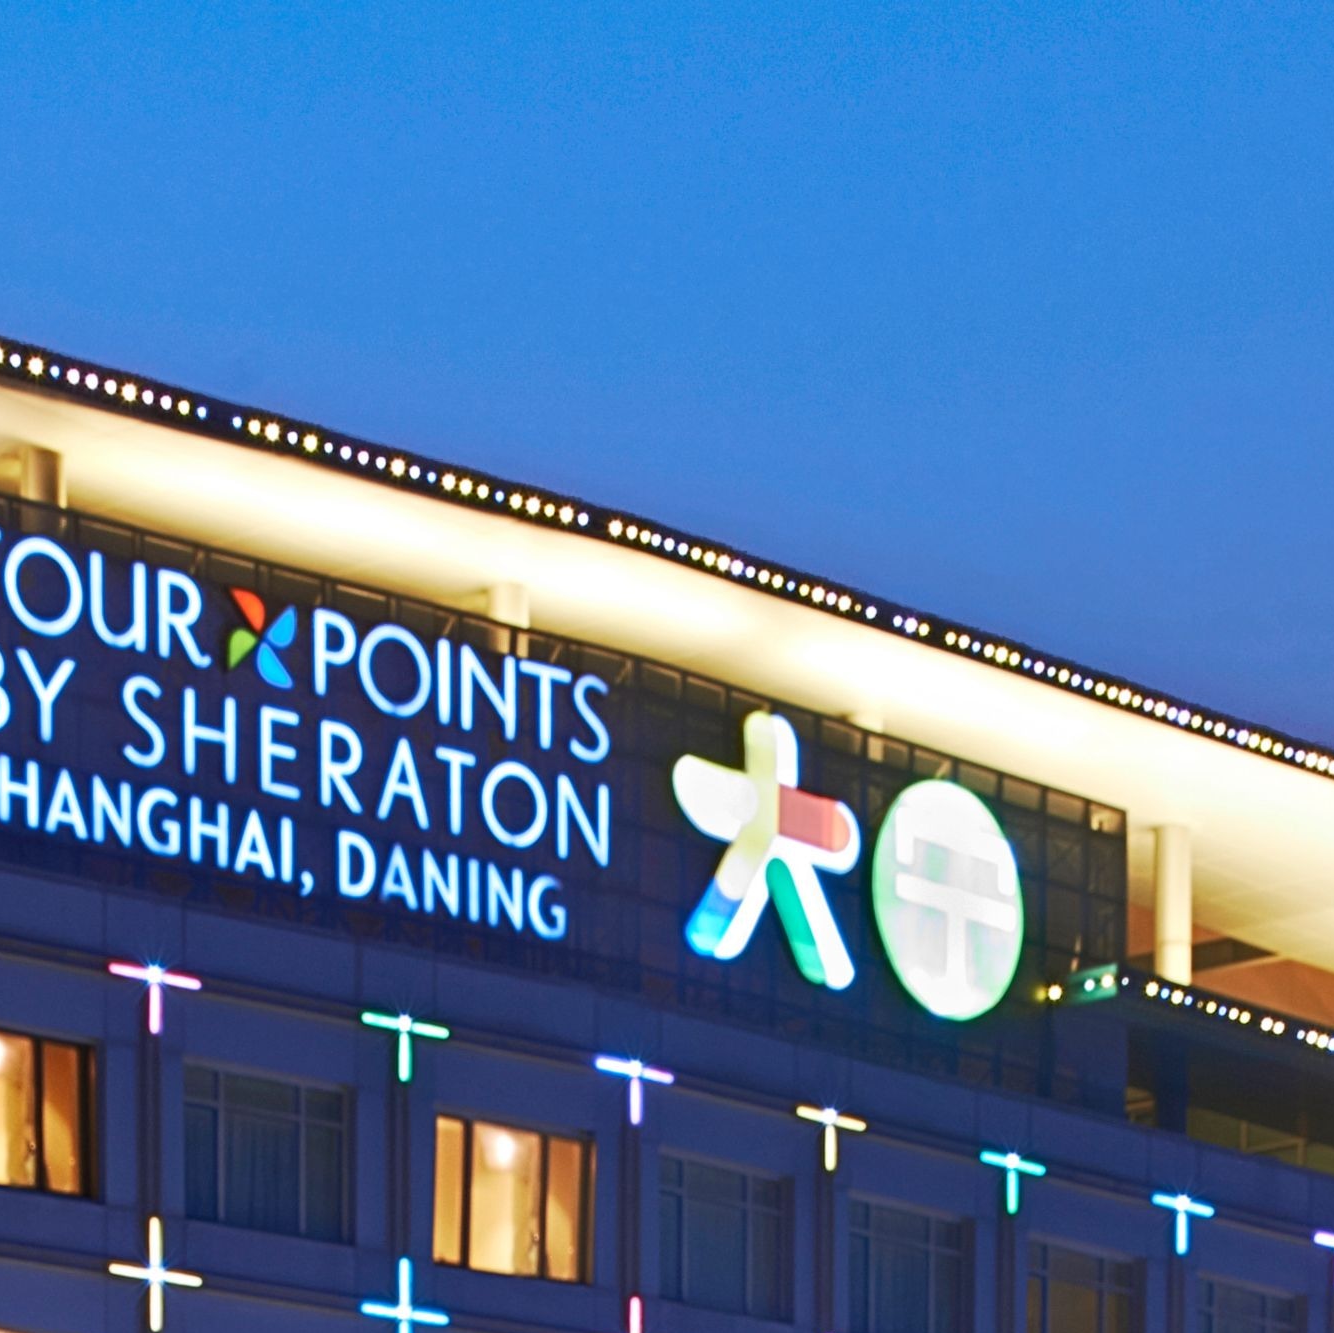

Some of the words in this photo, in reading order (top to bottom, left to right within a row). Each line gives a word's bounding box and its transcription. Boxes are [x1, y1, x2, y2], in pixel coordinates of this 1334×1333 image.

[312, 607, 610, 764] POINTS
[122, 675, 610, 868] SHERATON
[337, 829, 568, 940] DANING
